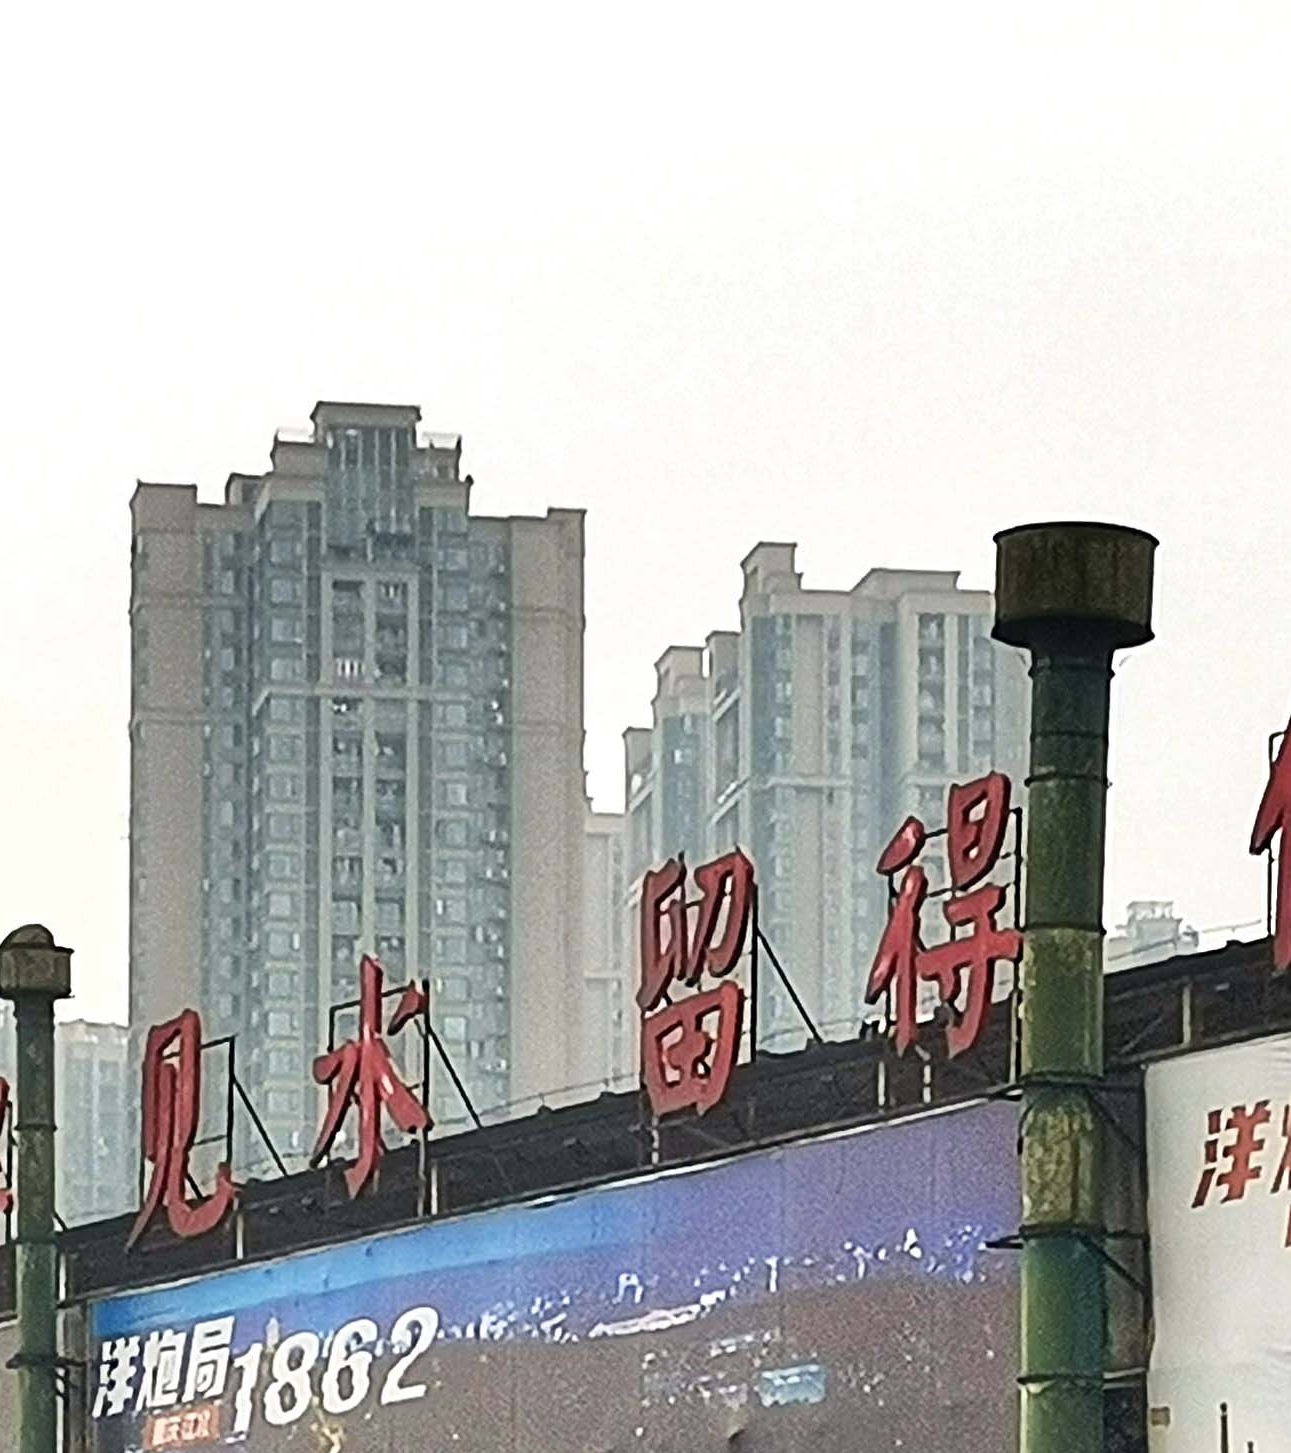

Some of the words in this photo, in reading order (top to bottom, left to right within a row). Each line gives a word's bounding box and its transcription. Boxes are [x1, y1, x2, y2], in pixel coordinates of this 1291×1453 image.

[92, 1316, 235, 1418] 洋炮局
[232, 1306, 440, 1435] 1862
